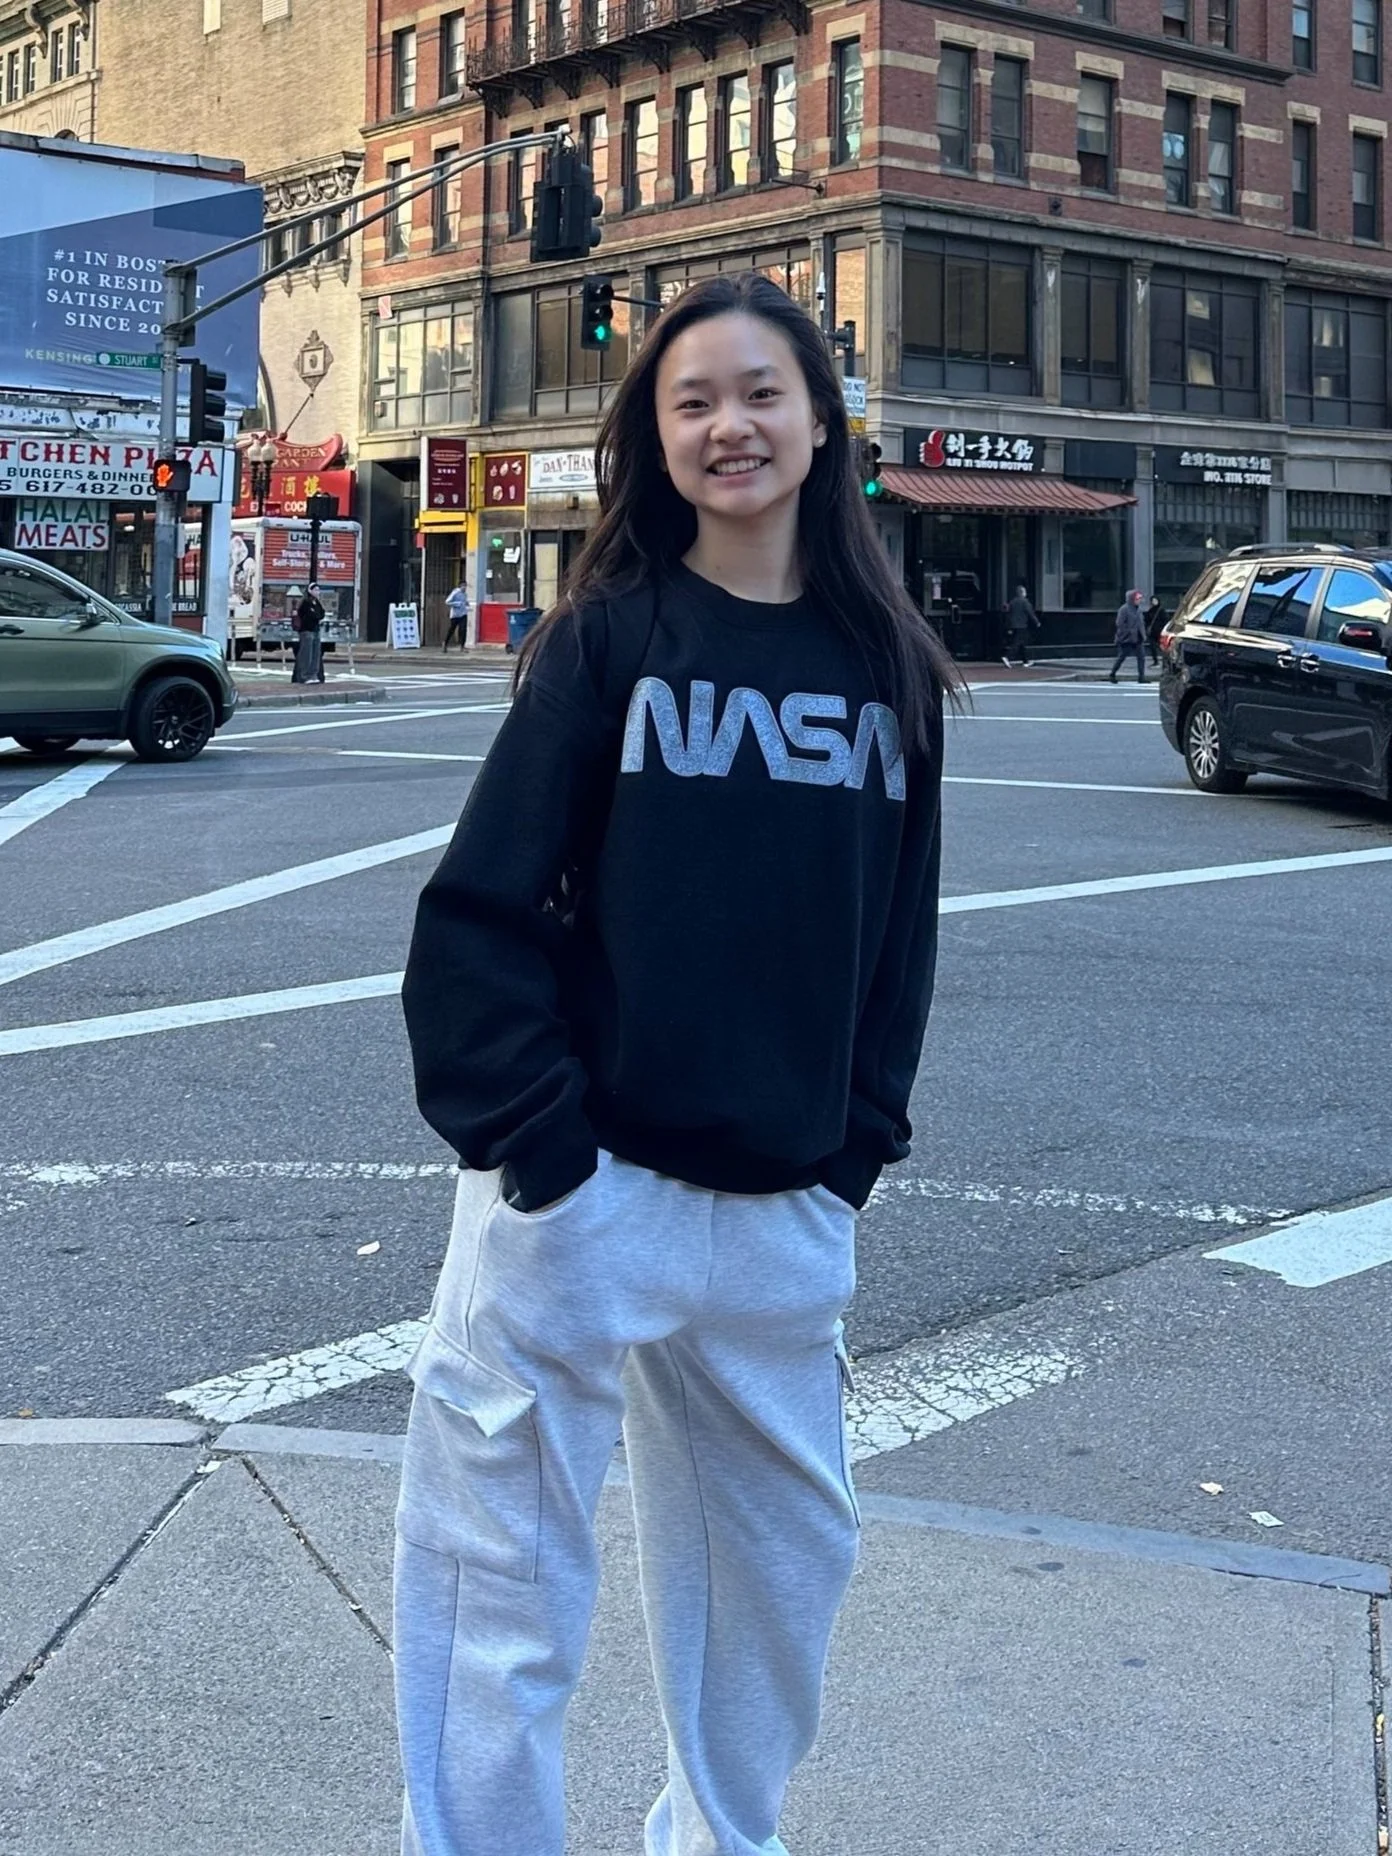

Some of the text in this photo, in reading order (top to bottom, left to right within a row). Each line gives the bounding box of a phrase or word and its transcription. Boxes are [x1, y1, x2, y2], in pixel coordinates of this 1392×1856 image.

[54, 249, 166, 273] #1 IN BOS
[47, 267, 204, 299] FOR RESIDT
[46, 288, 165, 315] SATISFACT
[65, 311, 162, 335] SINCE 20
[25, 348, 95, 365] KENSING
[114, 354, 148, 366] STUART
[0, 440, 218, 477] TCHEN PIA
[974, 459, 998, 470] SHOU
[999, 461, 1034, 472] HOTPOT
[7, 467, 156, 483] BURGERS & DINNE
[1243, 473, 1272, 486] STORE
[26, 480, 157, 496] 617-482-00
[19, 499, 107, 523] HALAL
[17, 523, 106, 548] MEATS
[290, 533, 331, 544] U-HUL
[178, 601, 197, 612] BREAD
[621, 676, 906, 800] NASA
